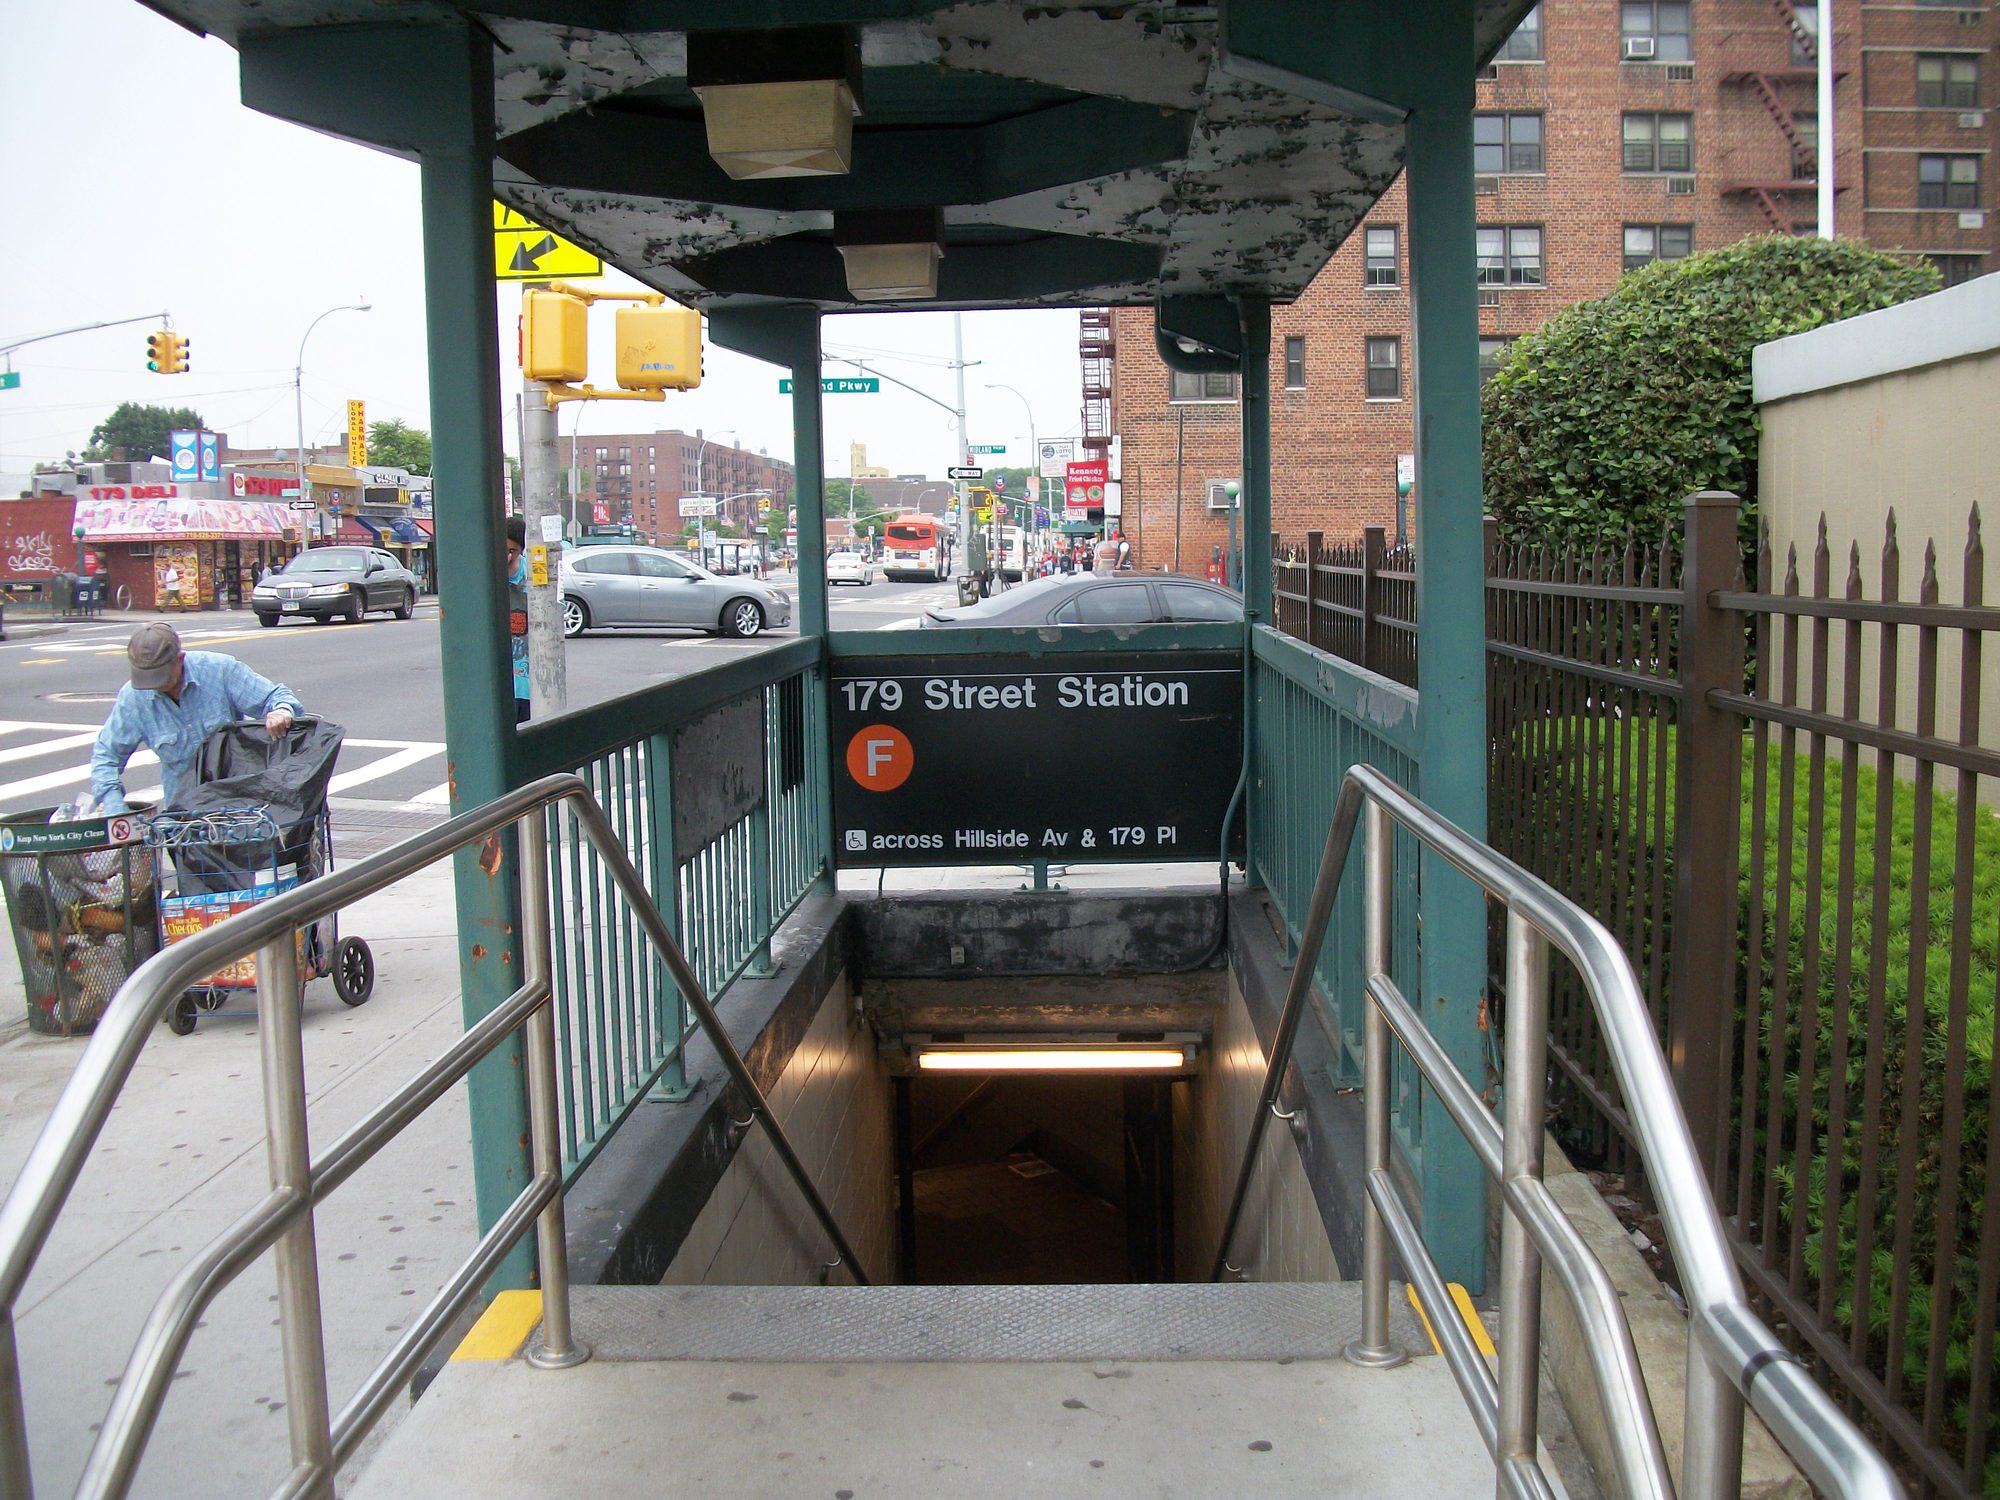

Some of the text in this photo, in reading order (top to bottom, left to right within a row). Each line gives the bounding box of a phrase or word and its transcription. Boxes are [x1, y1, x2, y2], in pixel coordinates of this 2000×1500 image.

[839, 381, 871, 391] Pkwy
[358, 402, 366, 465] PHARMACY
[1069, 467, 1103, 476] Kennedy
[90, 485, 177, 500] 179 DELI
[841, 675, 1188, 711] 179 Street Station
[866, 740, 894, 777] F
[33, 834, 47, 843] New
[48, 834, 65, 842] York
[67, 832, 83, 841] City
[84, 830, 105, 838] Clean
[872, 825, 1177, 849] across Hillside Av & 179 Pl
[167, 921, 203, 936] Cheerios
